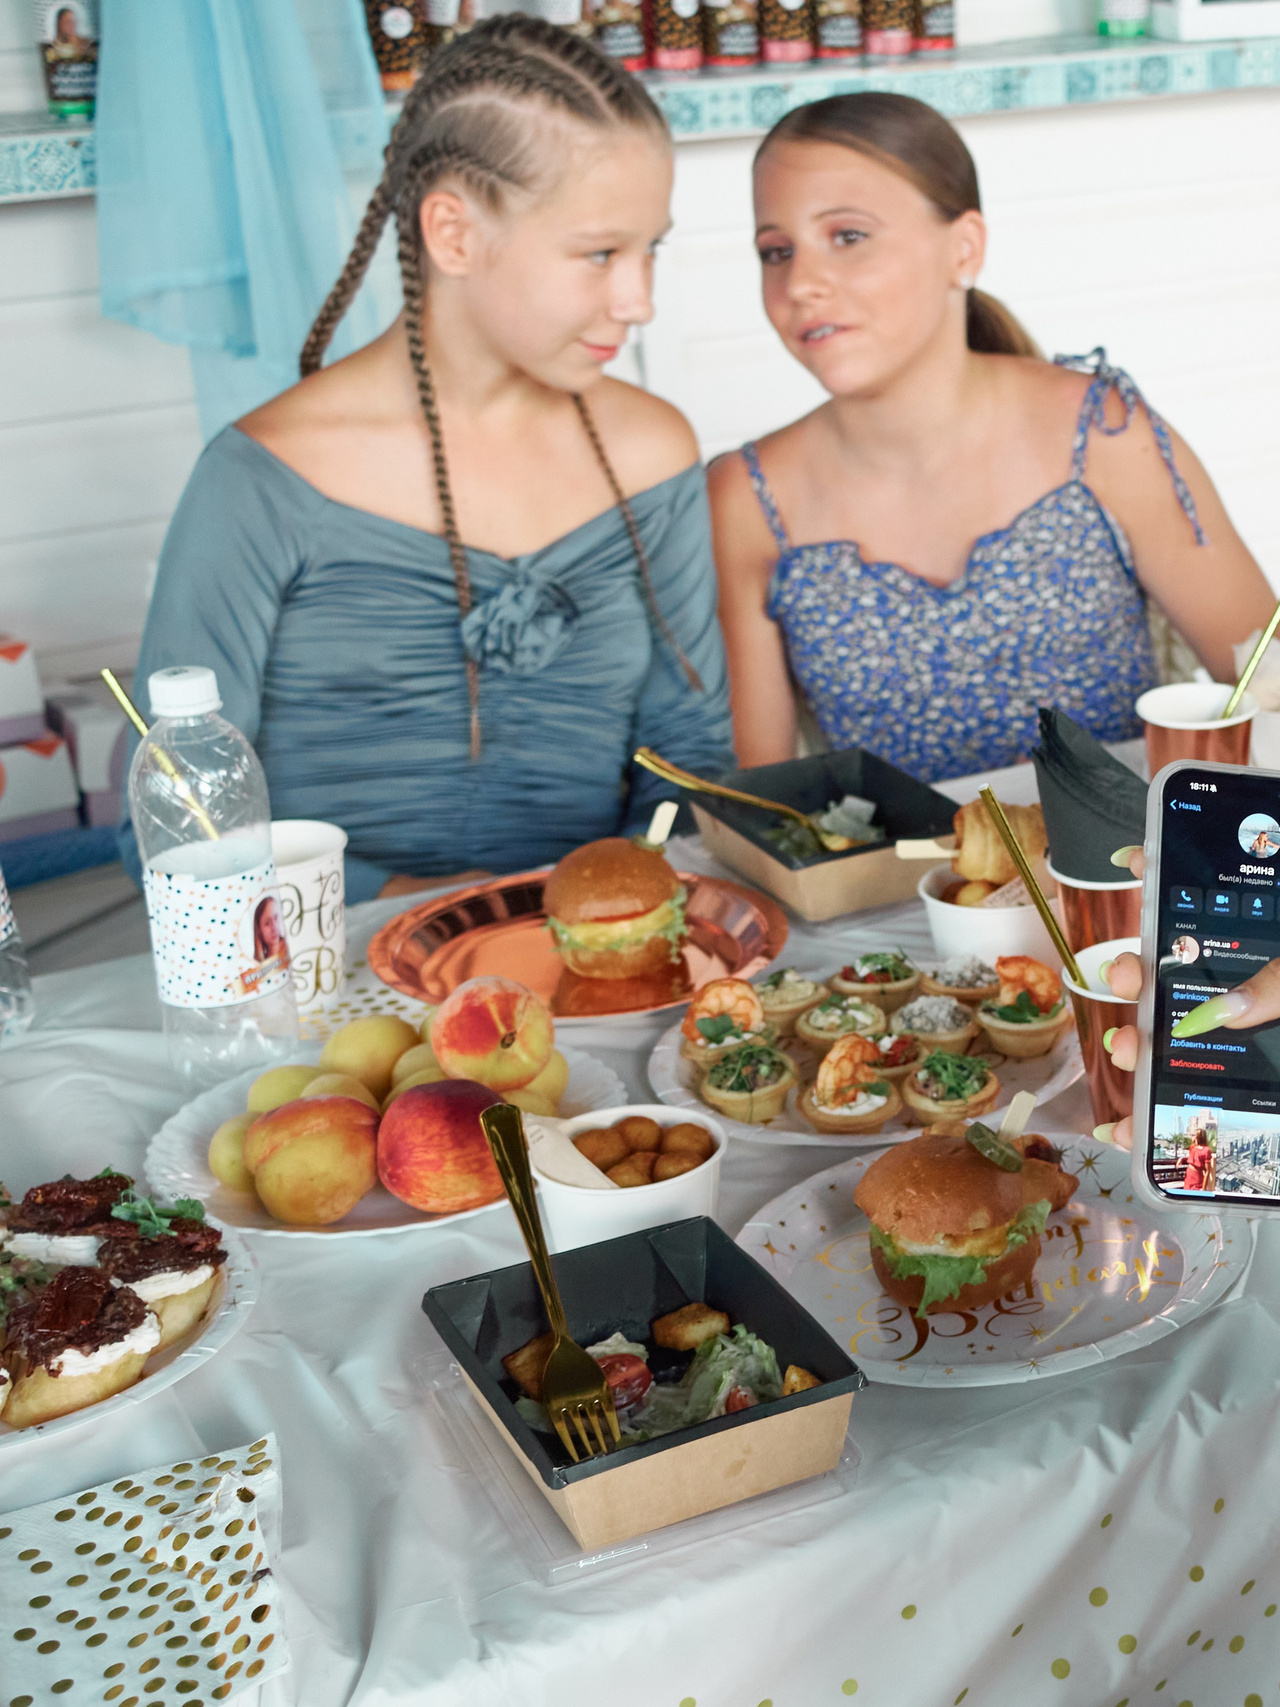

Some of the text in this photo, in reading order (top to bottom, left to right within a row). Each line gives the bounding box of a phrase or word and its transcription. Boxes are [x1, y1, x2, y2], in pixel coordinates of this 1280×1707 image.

[1189, 782, 1209, 792] 18:11
[1179, 802, 1202, 812] Назад
[1240, 864, 1275, 876] арина
[1219, 874, 1242, 884] был(а)
[1244, 878, 1273, 887] недавно
[1176, 922, 1197, 931] КАНАЛ
[1204, 940, 1231, 949] arina.ua
[1214, 950, 1270, 962] Видеосообщение
[1187, 984, 1228, 993] пользователя
[1170, 1038, 1206, 1050] Добавить
[1213, 1044, 1246, 1053] контакты
[1170, 1058, 1225, 1071] Заблокировать
[1184, 1092, 1223, 1103] Публикации
[1252, 1098, 1277, 1107] Ссылки
